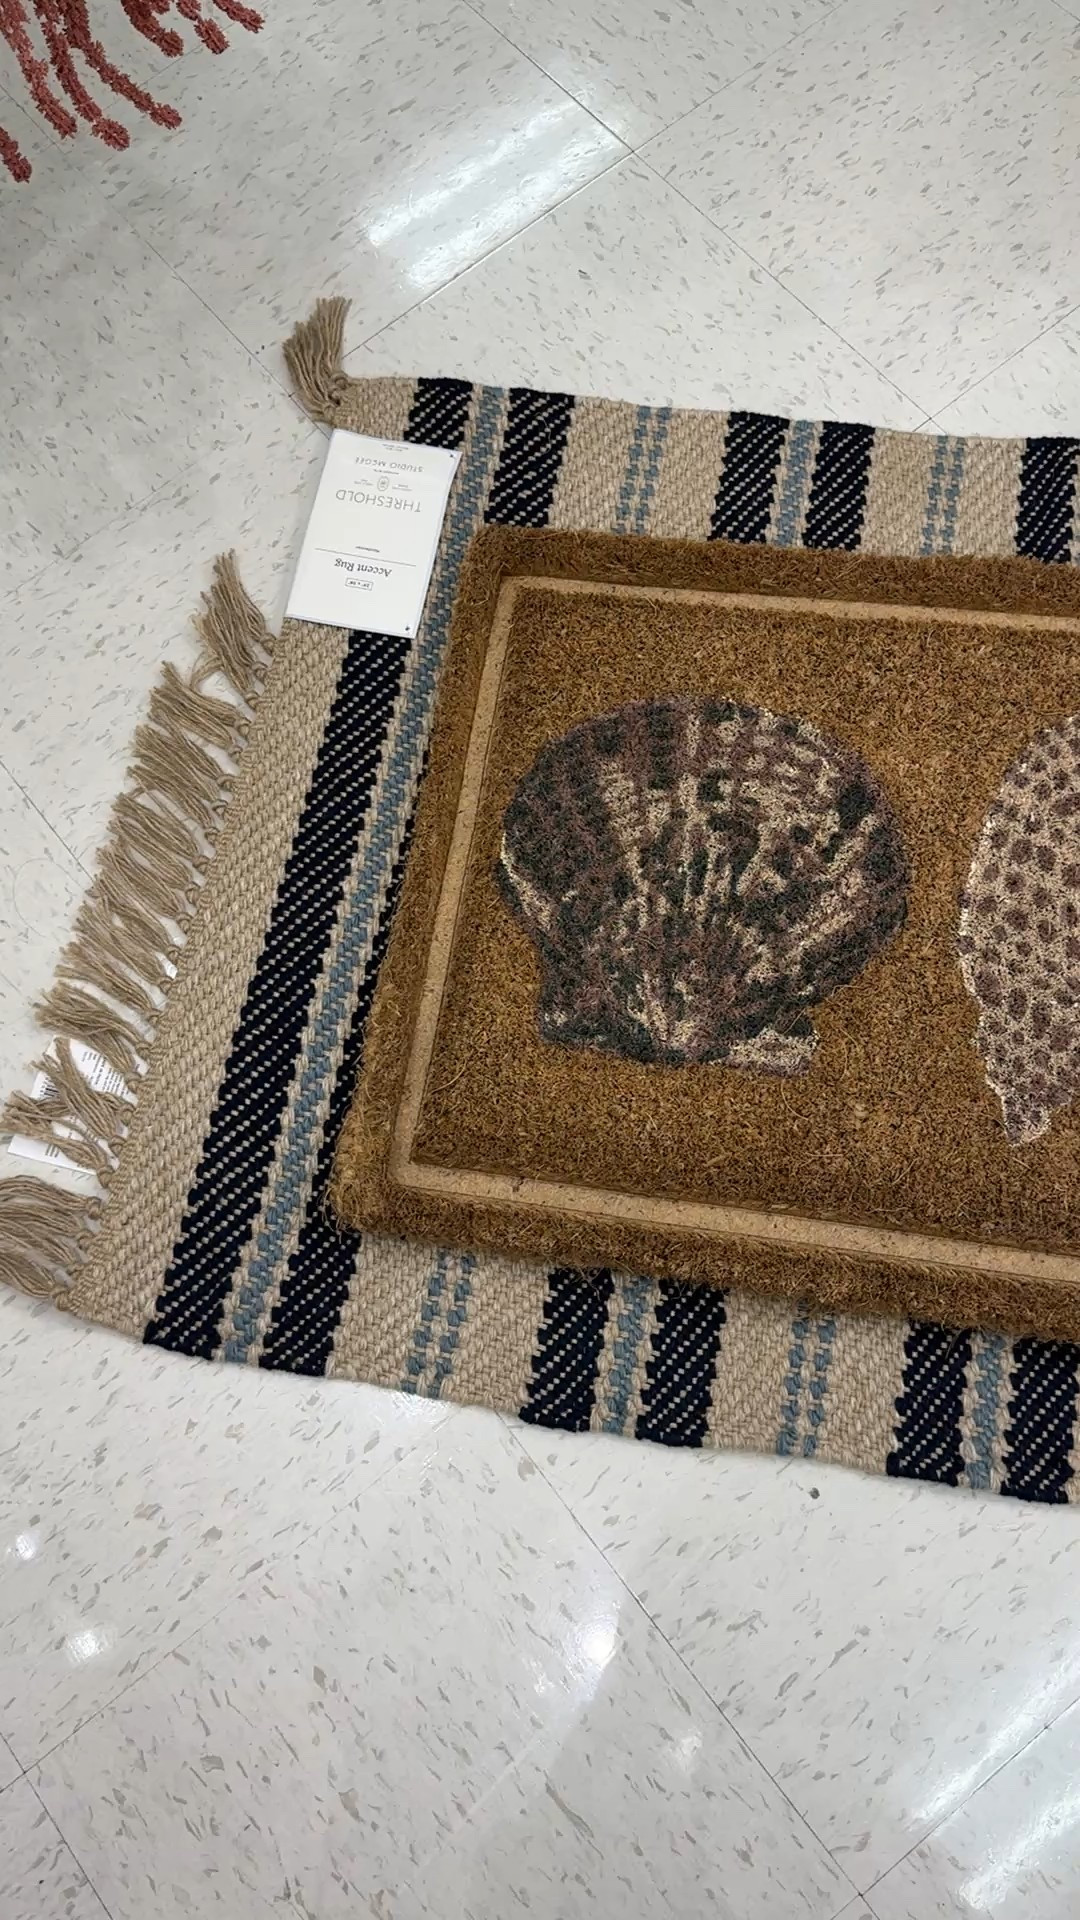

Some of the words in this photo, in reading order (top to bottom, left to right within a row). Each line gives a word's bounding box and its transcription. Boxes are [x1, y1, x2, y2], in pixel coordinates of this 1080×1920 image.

[389, 462, 425, 473] STUDIO
[335, 489, 422, 513] THRESHOLD
[334, 557, 355, 572] Rug
[357, 563, 393, 578] Accent
